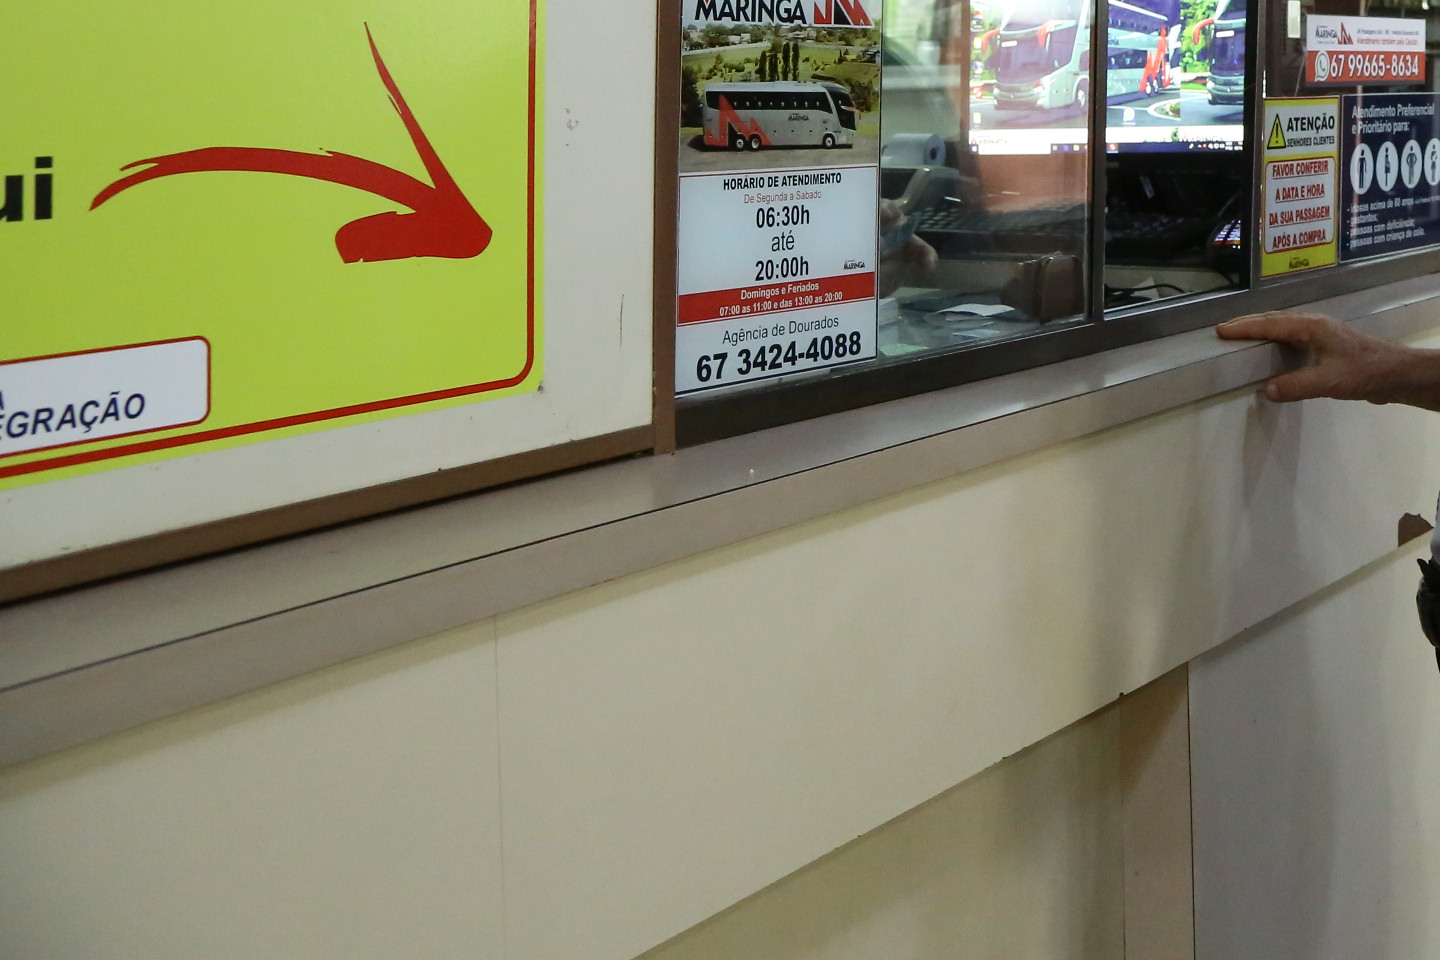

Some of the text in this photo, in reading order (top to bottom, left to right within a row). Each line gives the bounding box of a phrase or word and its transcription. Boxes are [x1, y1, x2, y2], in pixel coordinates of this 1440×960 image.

[1330, 54, 1419, 78] 67 99665-8634
[1352, 102, 1435, 119] Atendimento Preferencial
[1286, 112, 1335, 134] ATENÇÃO
[1358, 121, 1392, 134] Prioritário
[1313, 135, 1335, 145] CLIENTES
[1272, 160, 1329, 178] FAVOR CONFERIR
[723, 172, 842, 191] HORÁRIO DE ATENDIMENTO
[743, 194, 755, 204] De
[756, 191, 788, 205] Segunda
[789, 193, 794, 201] a
[1275, 184, 1325, 201] A DATA E HORA
[756, 204, 810, 228] 06:30h
[1269, 206, 1330, 226] DA SUA PASSAGEM
[771, 230, 795, 252] até
[1272, 229, 1326, 250] APÓS A COMPRA
[755, 256, 809, 282] 20:00h
[741, 282, 819, 300] Domingos e Feriados
[719, 306, 740, 317] 07:00
[742, 305, 751, 314] as
[753, 301, 772, 313] 11:00
[779, 298, 793, 308] das
[794, 295, 814, 306] 13:00
[814, 295, 823, 303] as
[824, 291, 843, 303] 20:00
[722, 315, 839, 347] Agência de Dourados
[696, 330, 861, 383] 67 3424-4088
[0, 390, 146, 440] GRAÇÃO
